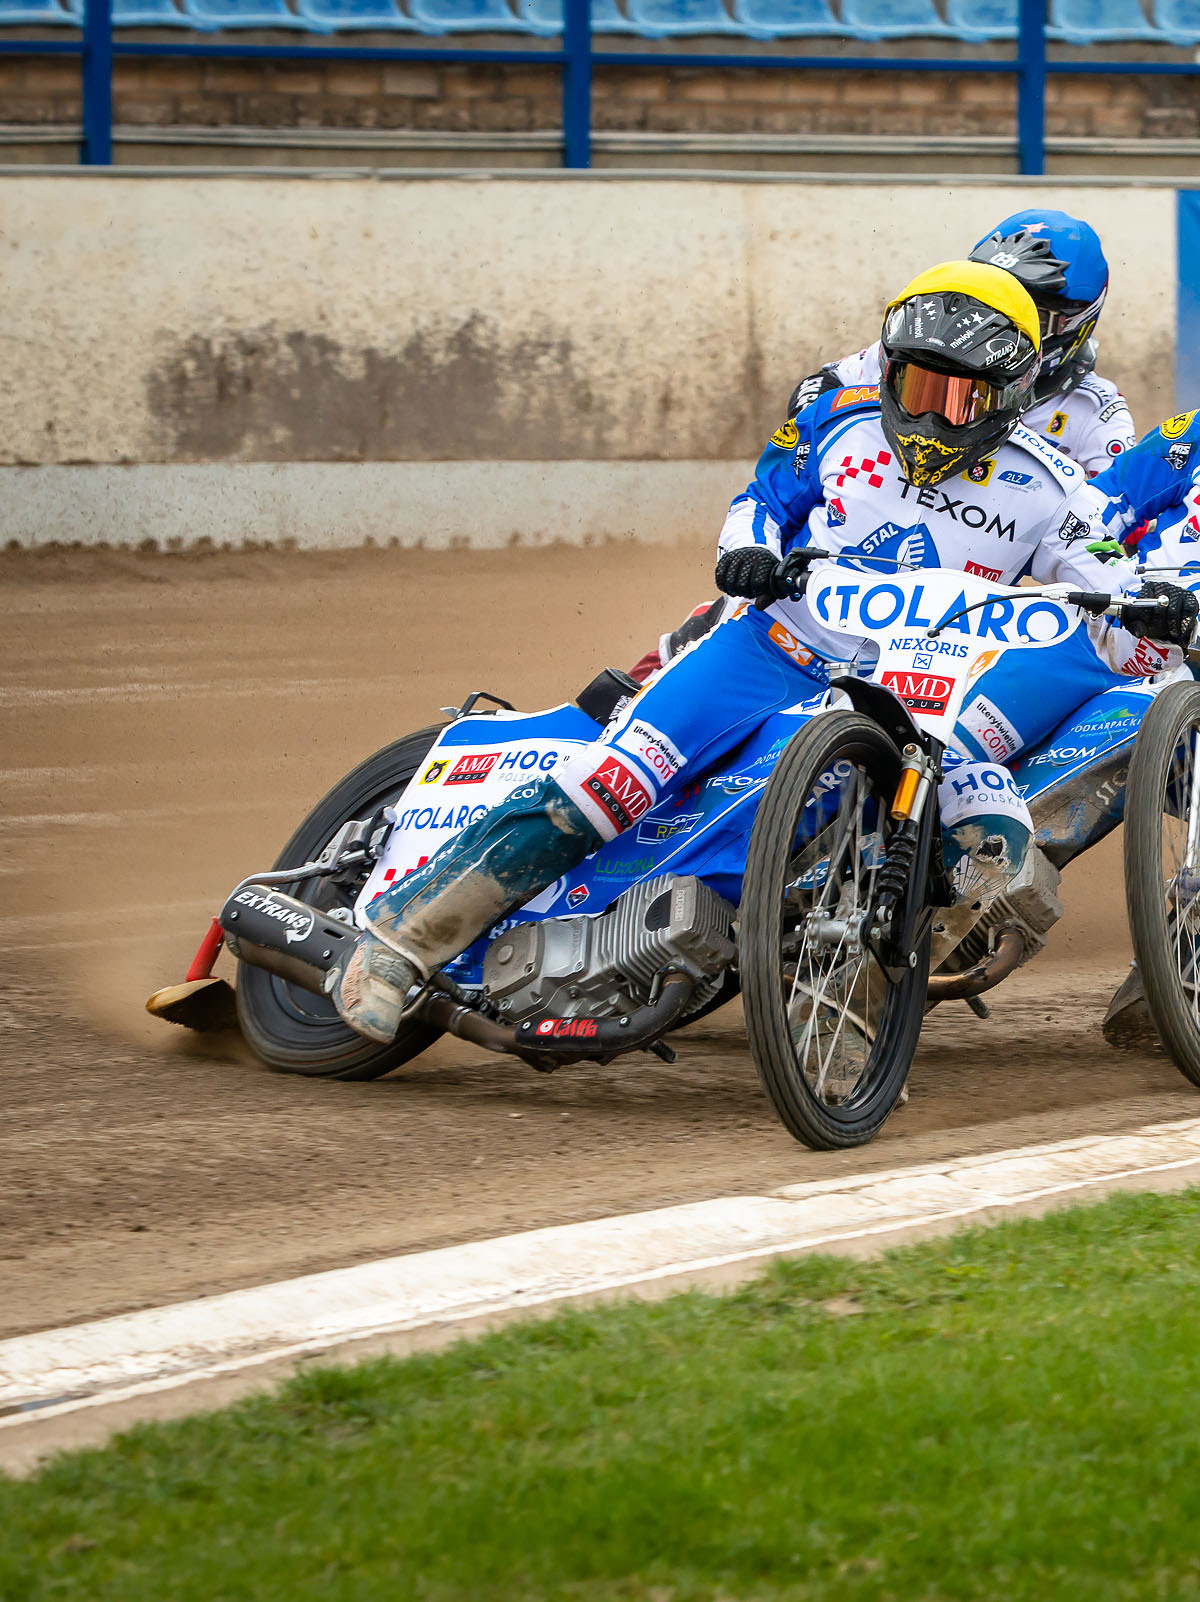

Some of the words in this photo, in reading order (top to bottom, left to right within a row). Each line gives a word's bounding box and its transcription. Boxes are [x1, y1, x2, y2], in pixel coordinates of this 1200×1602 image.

[985, 343, 1014, 366] EXTRANS
[1014, 429, 1075, 477] STOLARO
[898, 476, 1016, 542] TEXOM
[862, 523, 899, 554] STAL
[965, 565, 1000, 582] AMD
[816, 583, 1069, 643] STOLARO
[889, 637, 969, 659] NEXORIS
[882, 673, 950, 699] AMD
[906, 700, 942, 710] OUP
[977, 727, 1009, 762] .com
[1027, 746, 1097, 768] TEXOM
[453, 755, 499, 773] AMD
[499, 750, 559, 771] HOG
[639, 746, 675, 780] .com
[449, 773, 486, 781] GROUP
[598, 766, 649, 819] AMD
[394, 804, 488, 831] STOLARO
[234, 891, 312, 929] EXTRANS
